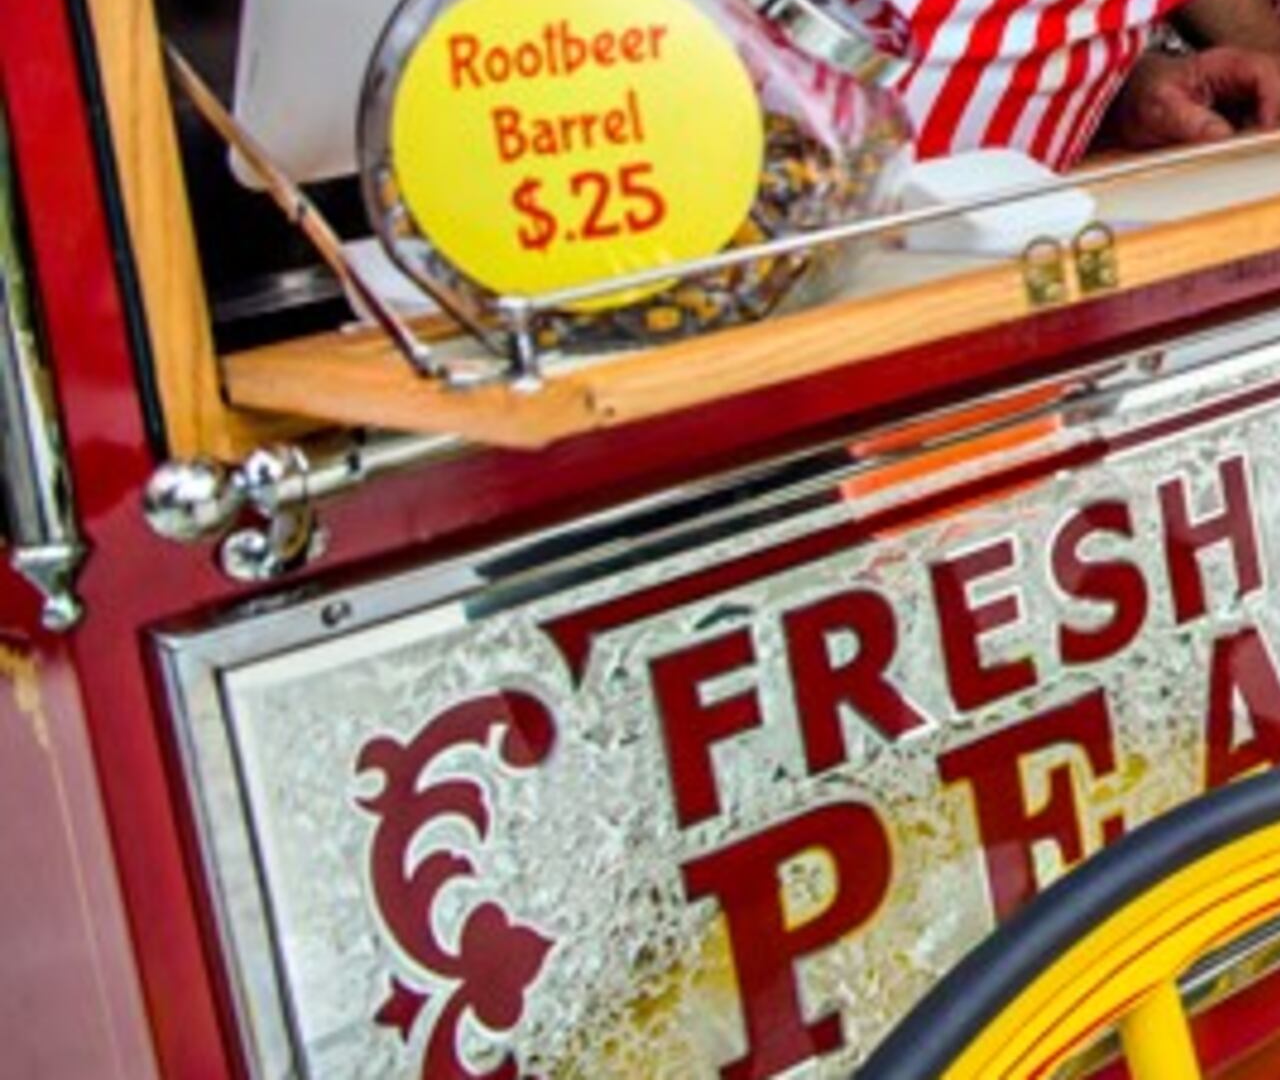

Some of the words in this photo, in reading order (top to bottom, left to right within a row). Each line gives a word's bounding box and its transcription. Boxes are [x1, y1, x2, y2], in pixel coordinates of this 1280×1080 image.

[447, 19, 668, 90] Rootbeer
[491, 90, 646, 164] Barrel
[512, 163, 668, 253] $.25
[648, 454, 1268, 830] FRESH
